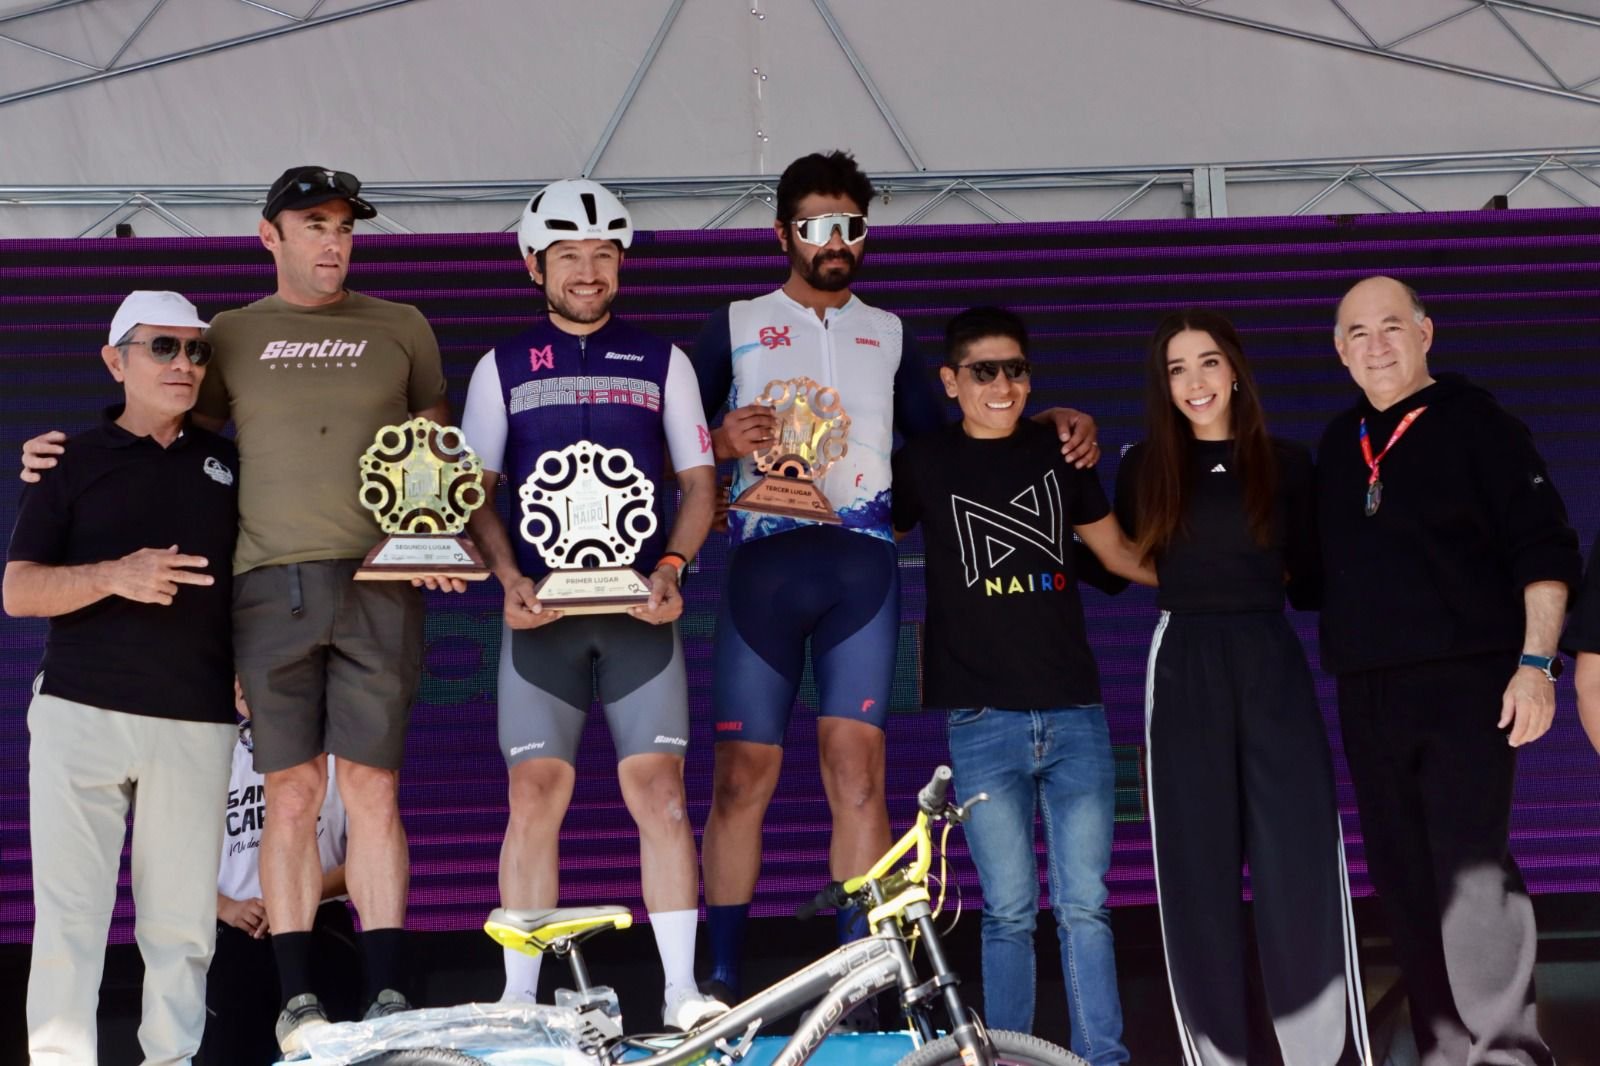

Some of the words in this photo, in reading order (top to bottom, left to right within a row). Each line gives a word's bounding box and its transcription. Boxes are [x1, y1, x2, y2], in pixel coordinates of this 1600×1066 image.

[260, 339, 367, 360] Santini
[604, 351, 645, 362] Santini
[269, 362, 357, 370] CYCLING
[766, 485, 789, 494] TERCER
[573, 506, 604, 526] NAIRO
[594, 576, 619, 584] LUGAR
[985, 572, 1067, 597] NAIRO
[510, 740, 545, 757] Santini
